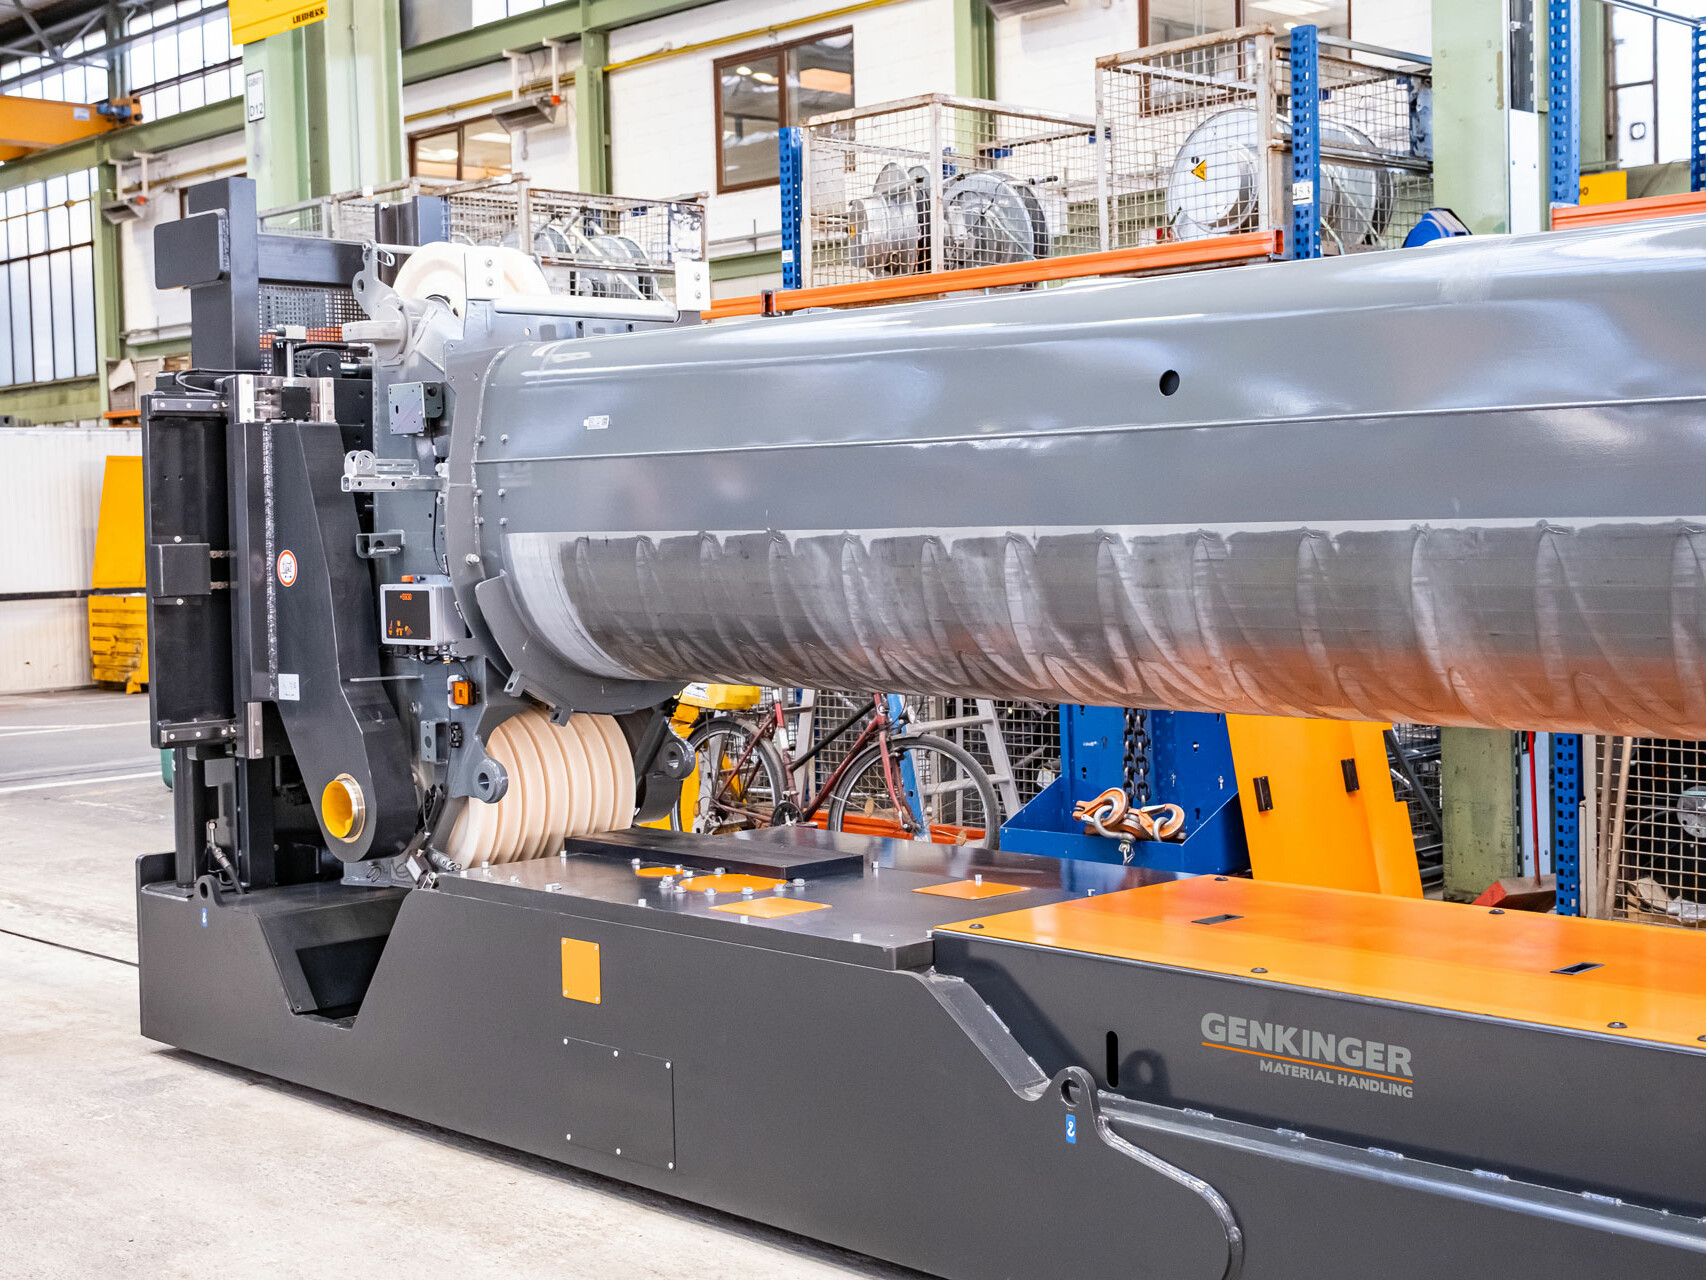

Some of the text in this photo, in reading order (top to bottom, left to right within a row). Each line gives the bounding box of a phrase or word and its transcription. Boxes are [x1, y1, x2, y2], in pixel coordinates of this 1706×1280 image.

[249, 102, 263, 117] D12
[1200, 1012, 1414, 1077] GENKINGER
[1259, 1059, 1413, 1099] MATERIAL HANDLING
